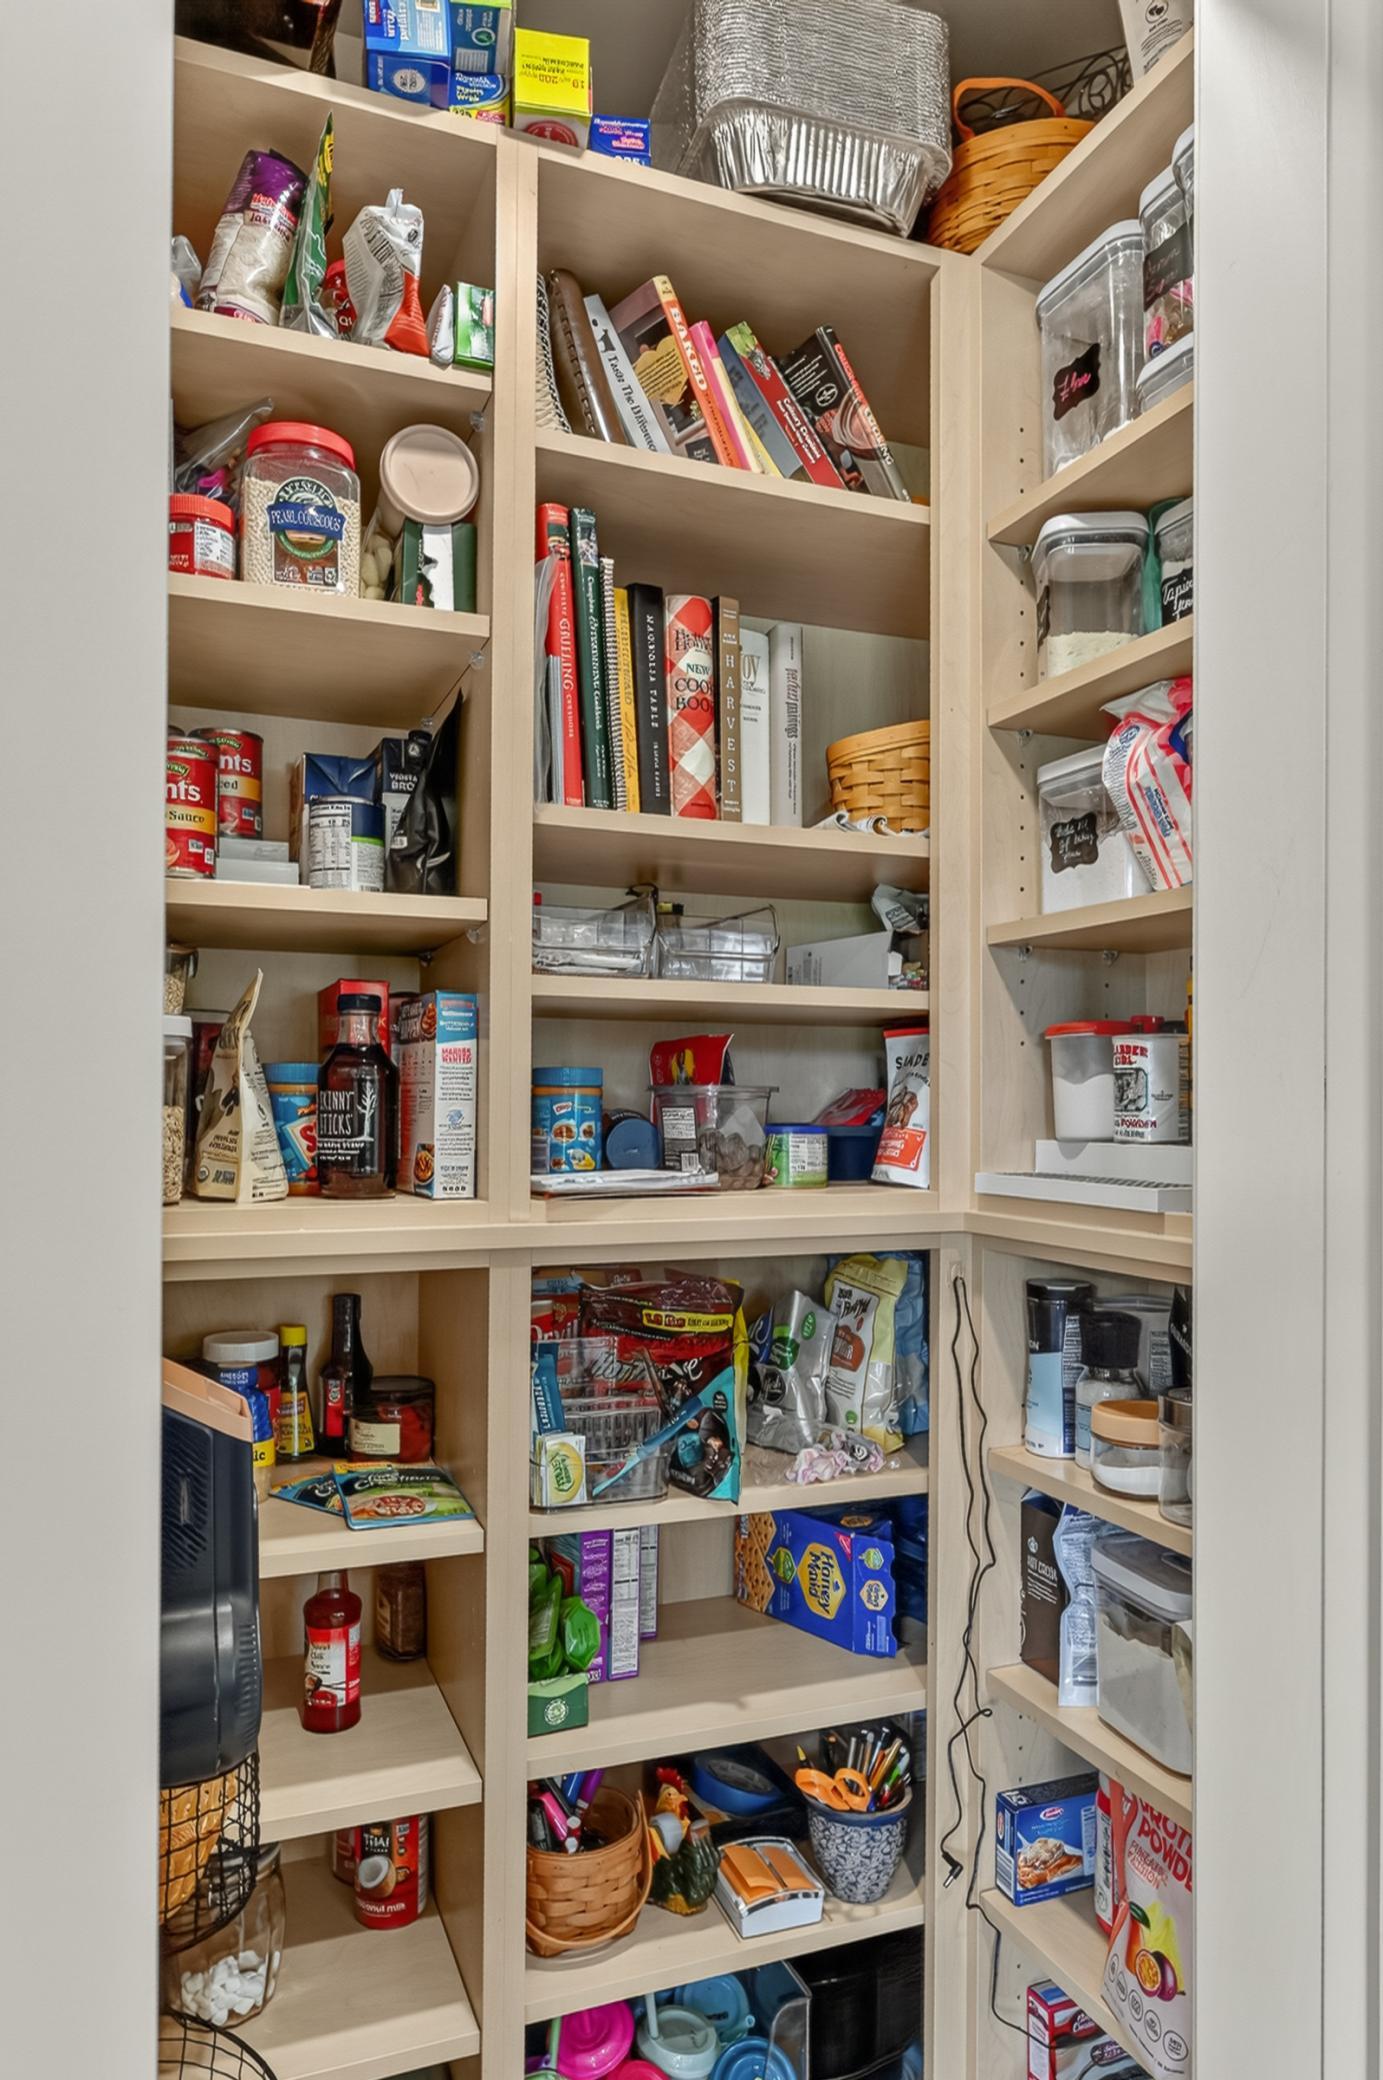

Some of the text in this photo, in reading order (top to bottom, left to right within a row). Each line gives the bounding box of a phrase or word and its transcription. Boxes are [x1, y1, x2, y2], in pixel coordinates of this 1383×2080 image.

[270, 509, 298, 525] PEARL
[686, 663, 711, 676] NEW
[649, 689, 659, 729] TABLE
[676, 694, 713, 713] BOO
[726, 655, 737, 793] HARVEST
[219, 754, 252, 773] nts
[389, 772, 418, 783] VEGETA
[391, 781, 415, 791] BRO
[169, 810, 205, 824] Sauce
[809, 1551, 821, 1601] Maid
[820, 1551, 832, 1615] Honey
[1137, 1815, 1192, 1894] POWDE
